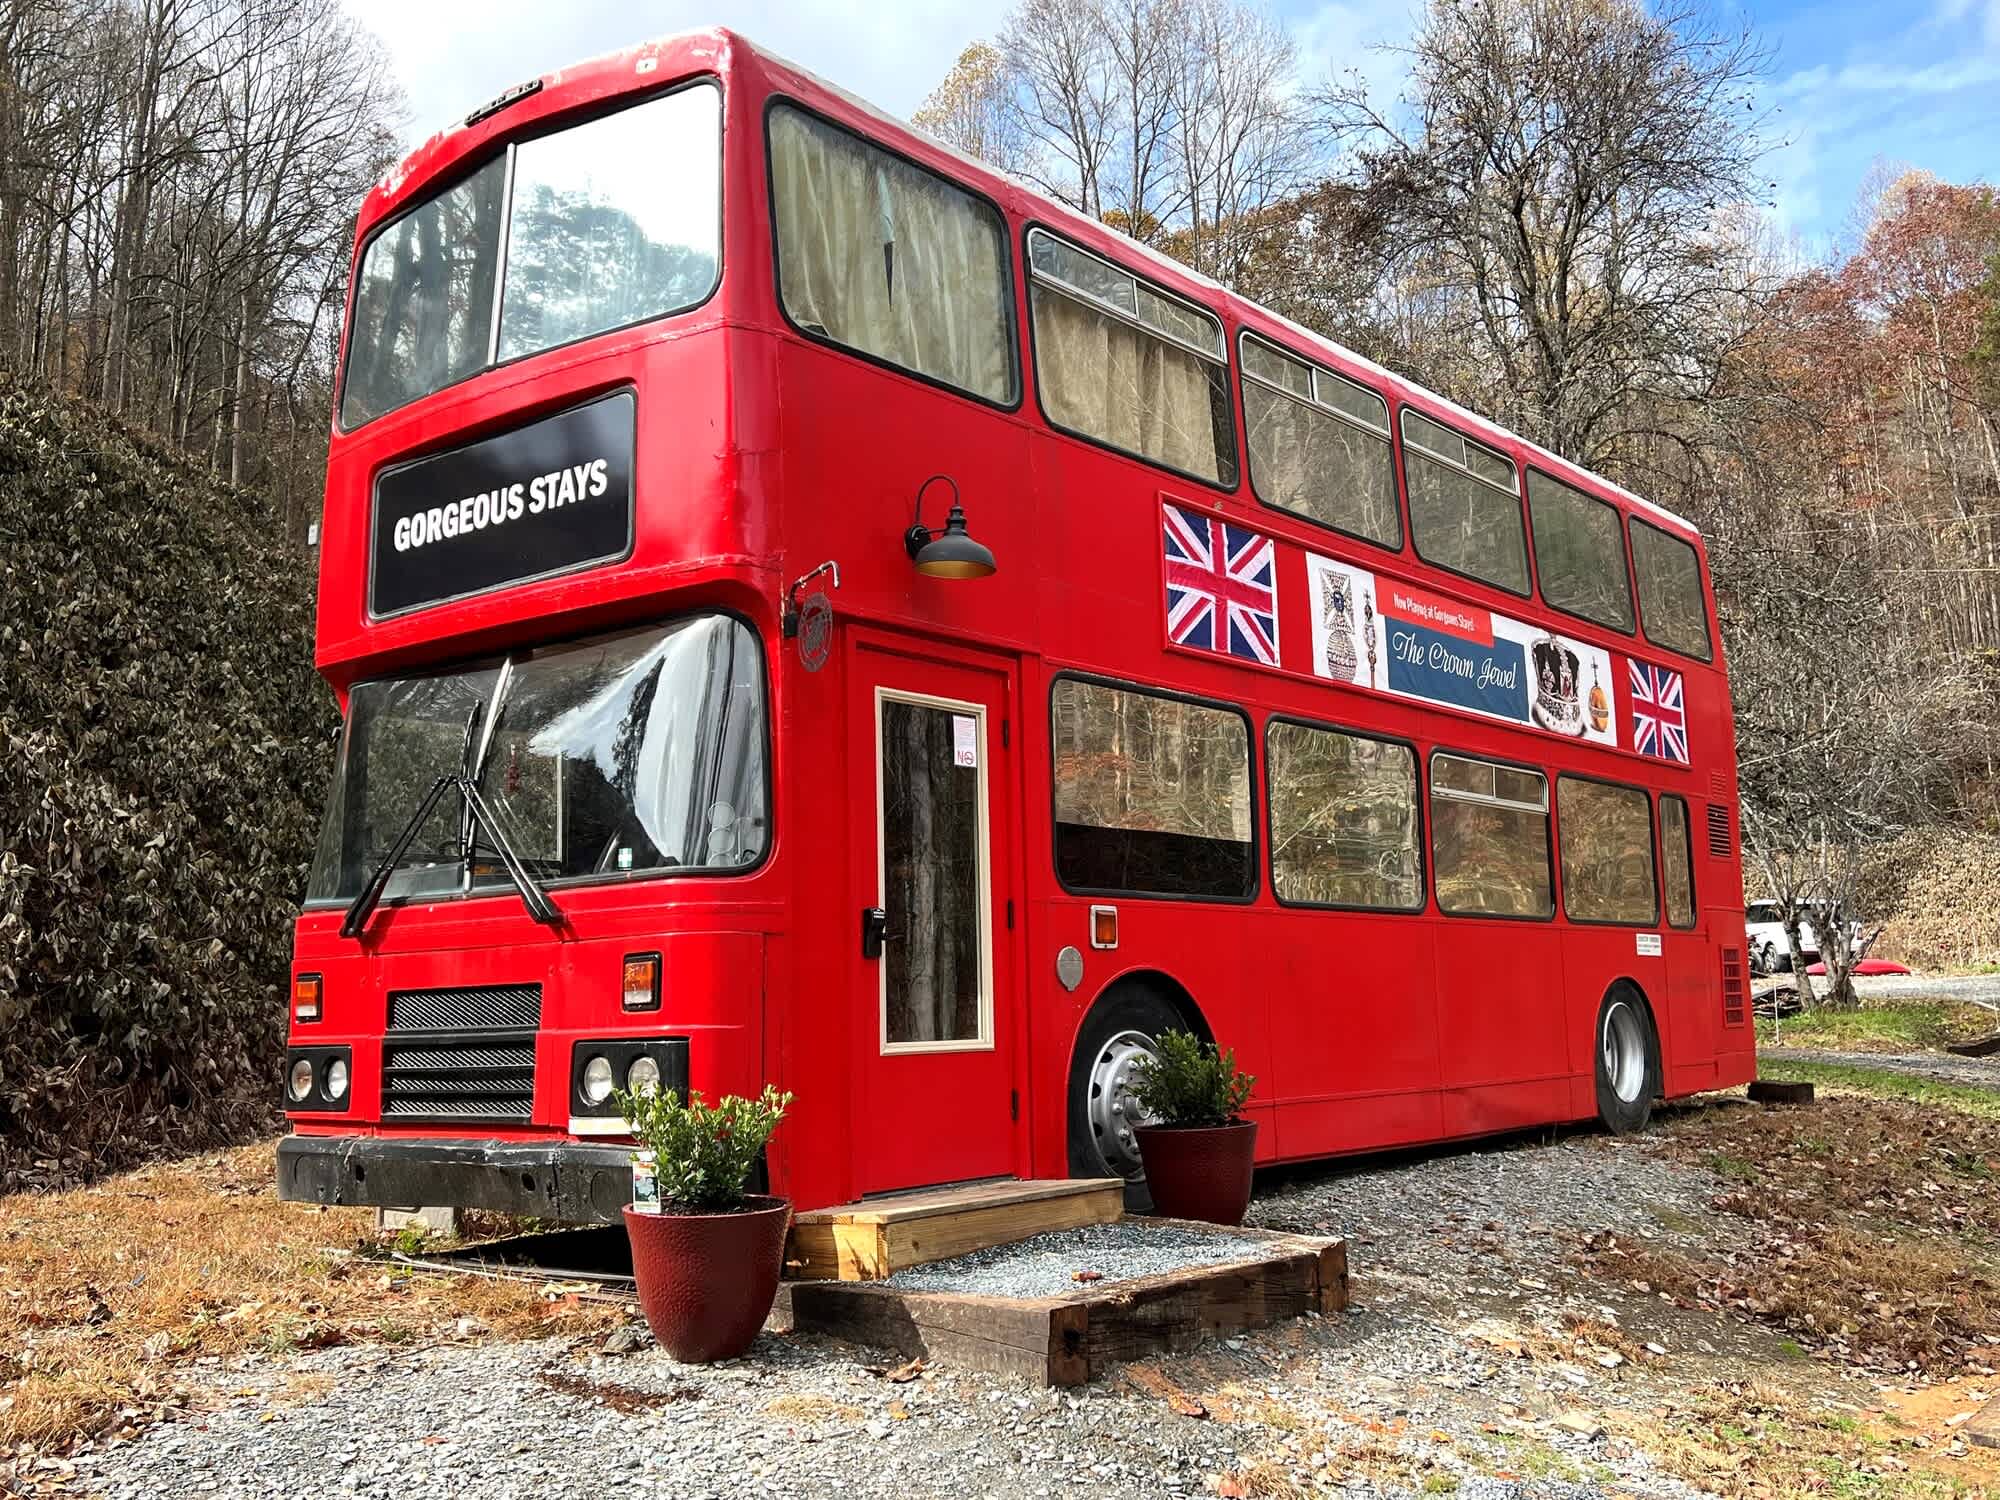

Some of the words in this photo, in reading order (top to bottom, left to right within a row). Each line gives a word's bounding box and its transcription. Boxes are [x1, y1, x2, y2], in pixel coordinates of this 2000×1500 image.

[394, 484, 525, 552] GORGEOUS
[528, 458, 608, 514] STAYS
[1393, 592, 1407, 610] Now
[1406, 597, 1427, 619] Playing
[1427, 604, 1434, 619] at
[1433, 606, 1458, 626] Gorgeous
[1392, 631, 1425, 665] The
[1428, 642, 1475, 679] Crown
[1477, 657, 1517, 690] Jewel
